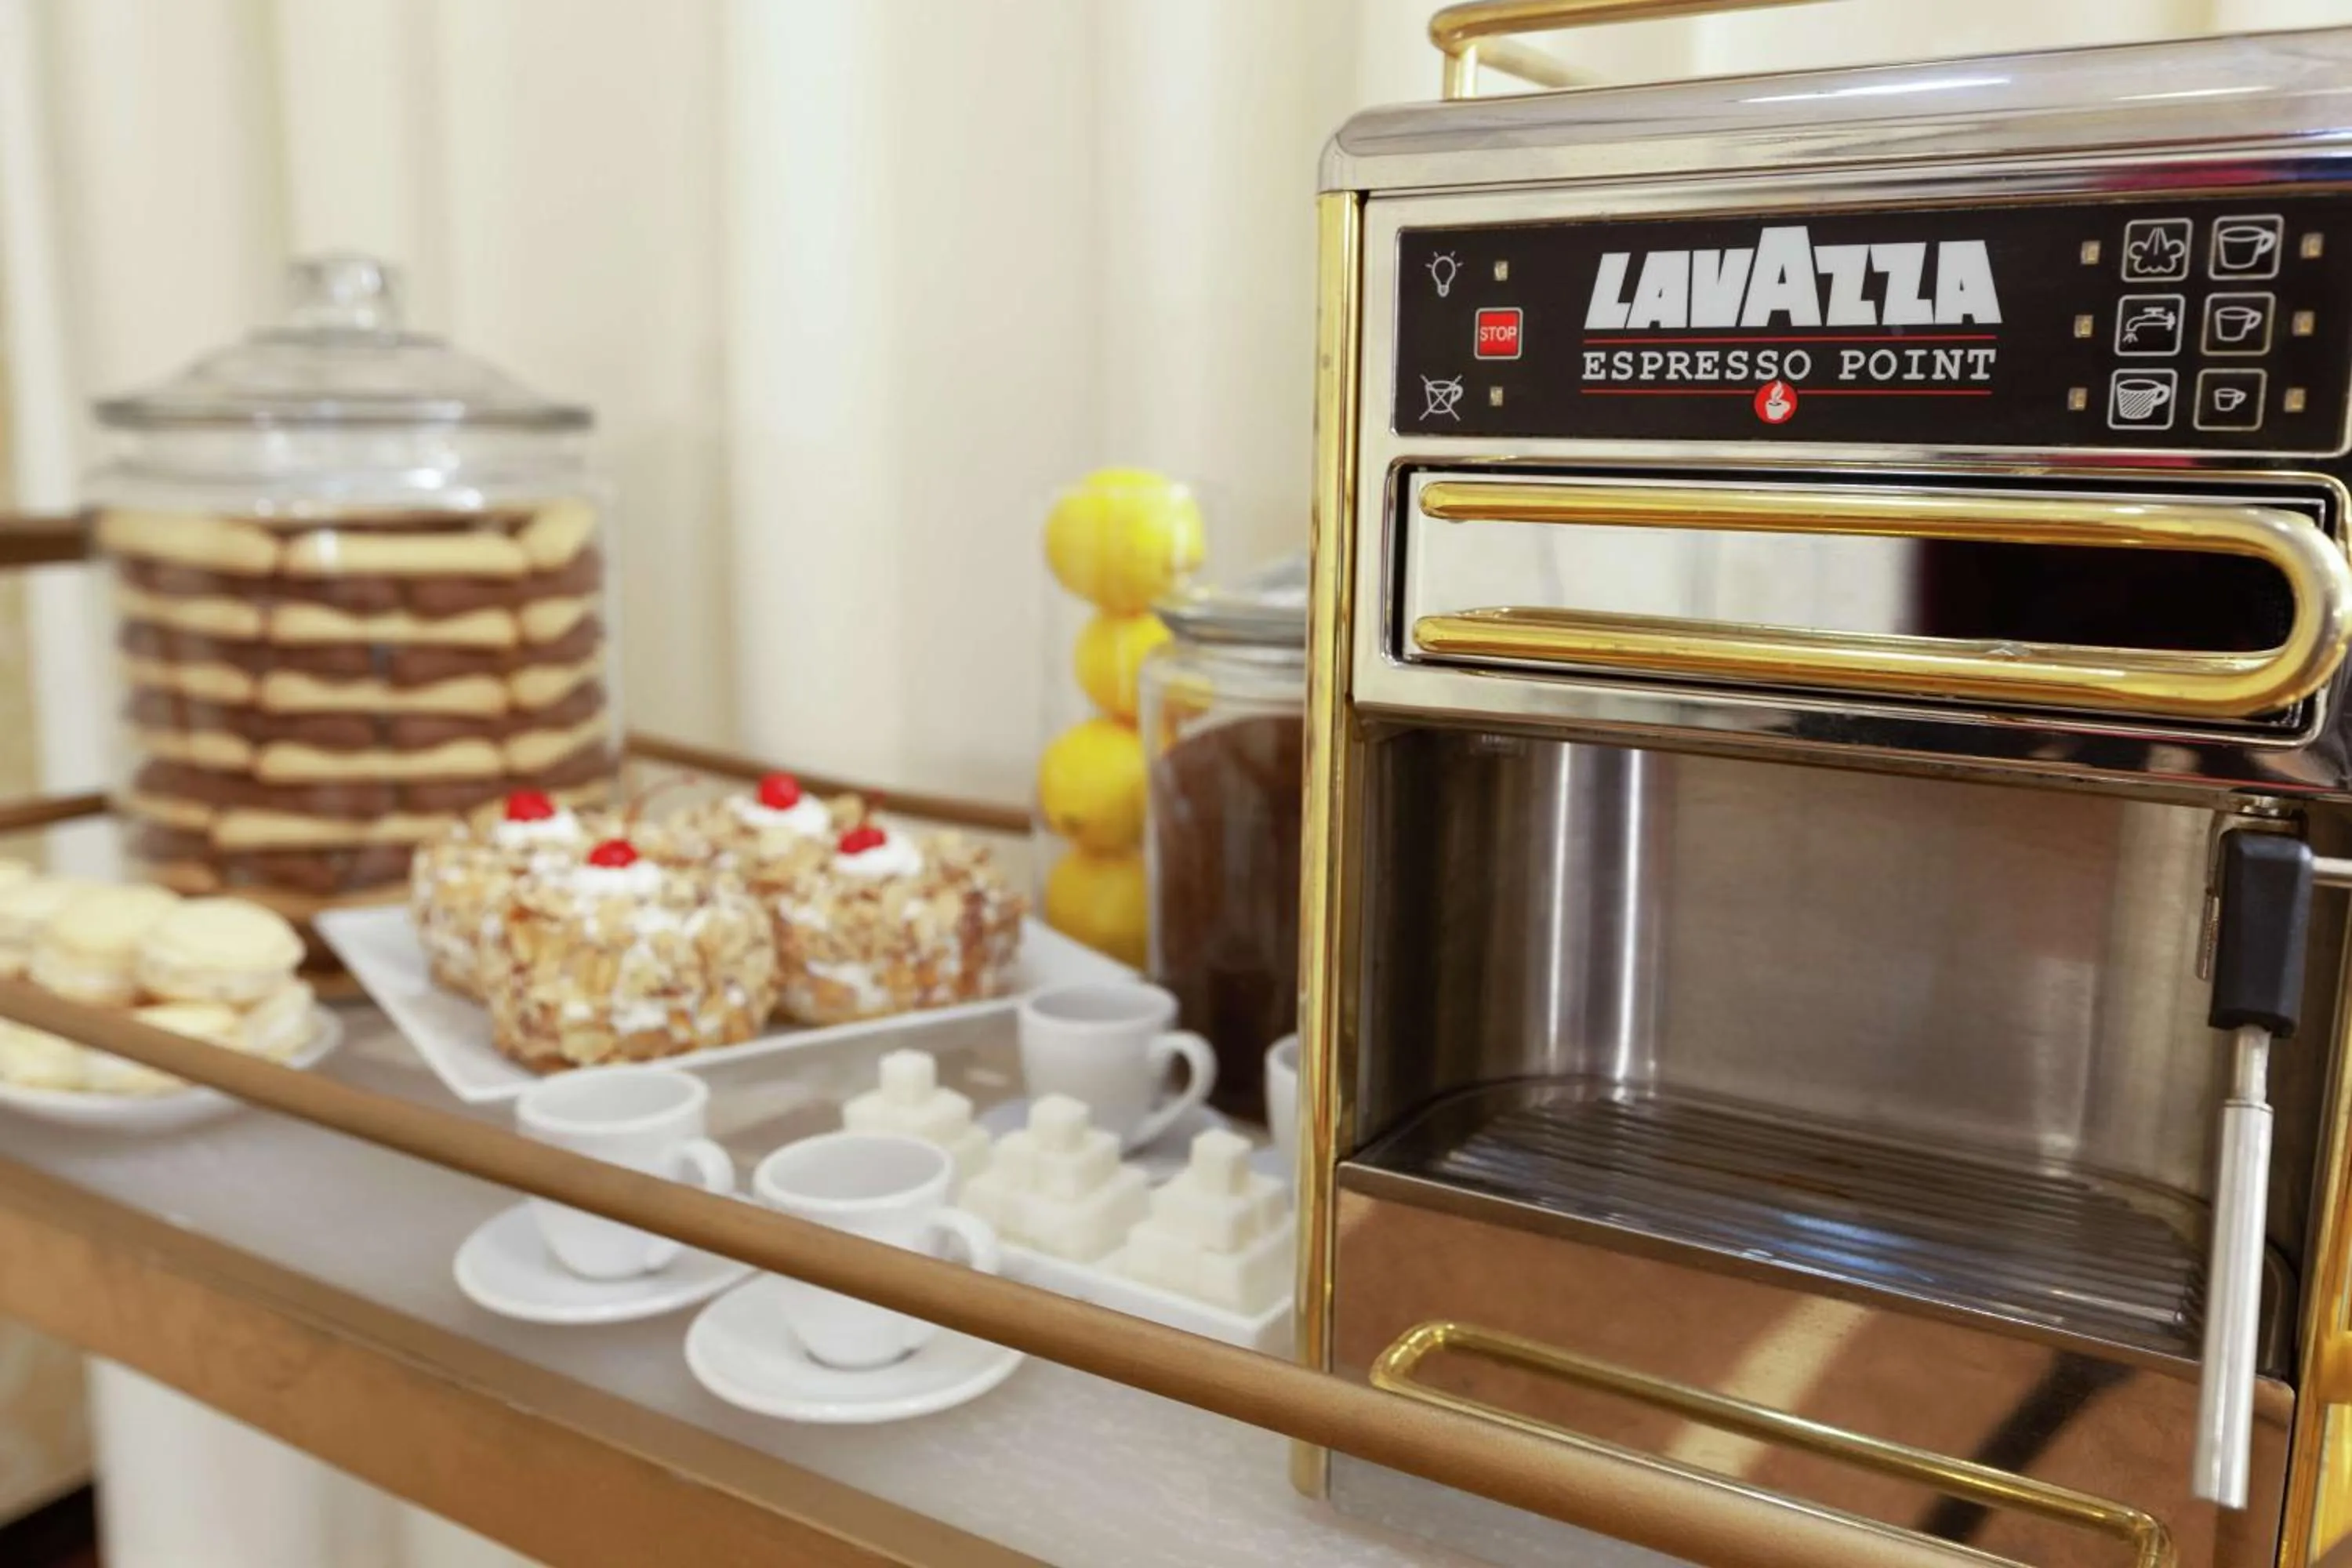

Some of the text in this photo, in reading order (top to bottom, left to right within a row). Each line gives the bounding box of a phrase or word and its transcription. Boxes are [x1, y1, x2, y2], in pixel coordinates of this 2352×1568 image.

[1584, 226, 2002, 328] LAVAZZA
[1479, 325, 1517, 342] STOP
[1582, 349, 1997, 381] ESPRESSO POINT
